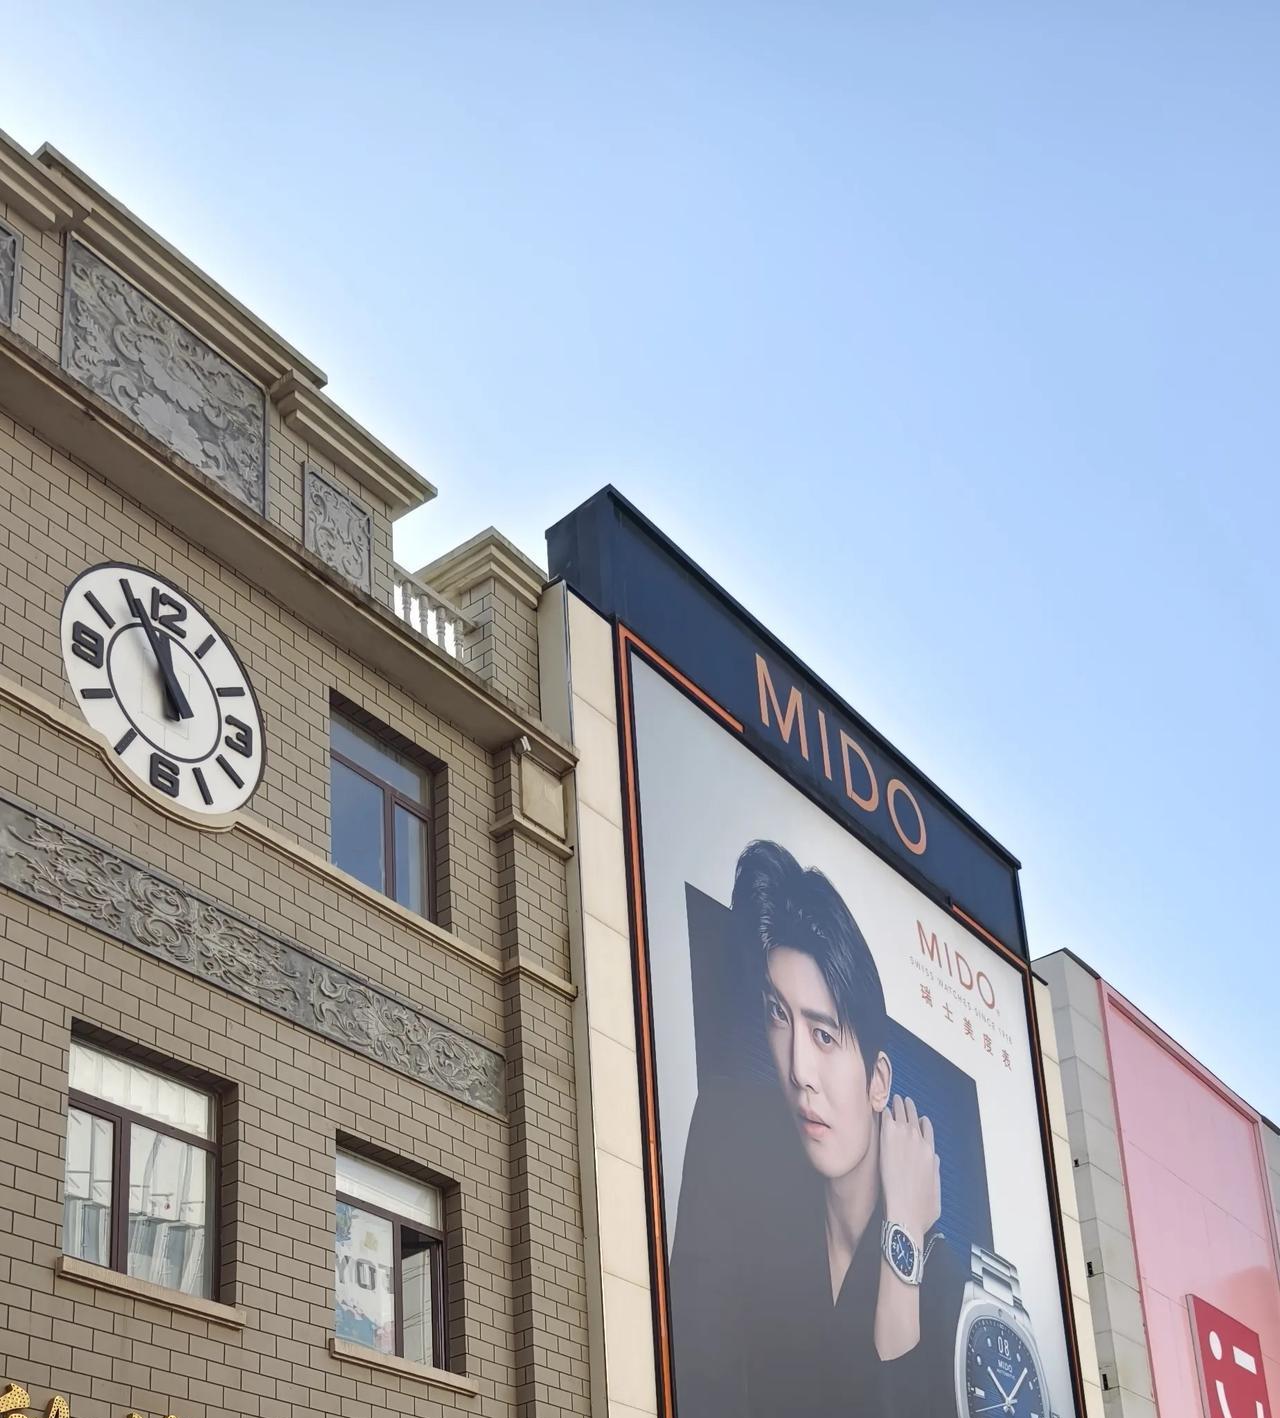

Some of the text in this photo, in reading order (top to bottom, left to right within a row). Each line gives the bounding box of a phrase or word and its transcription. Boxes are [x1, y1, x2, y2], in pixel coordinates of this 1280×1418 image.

[150, 586, 188, 639] 12
[72, 620, 105, 669] 9
[224, 714, 253, 759] 3
[755, 651, 928, 856] MIDO
[149, 752, 180, 798] 6
[916, 919, 996, 1010] MIDO
